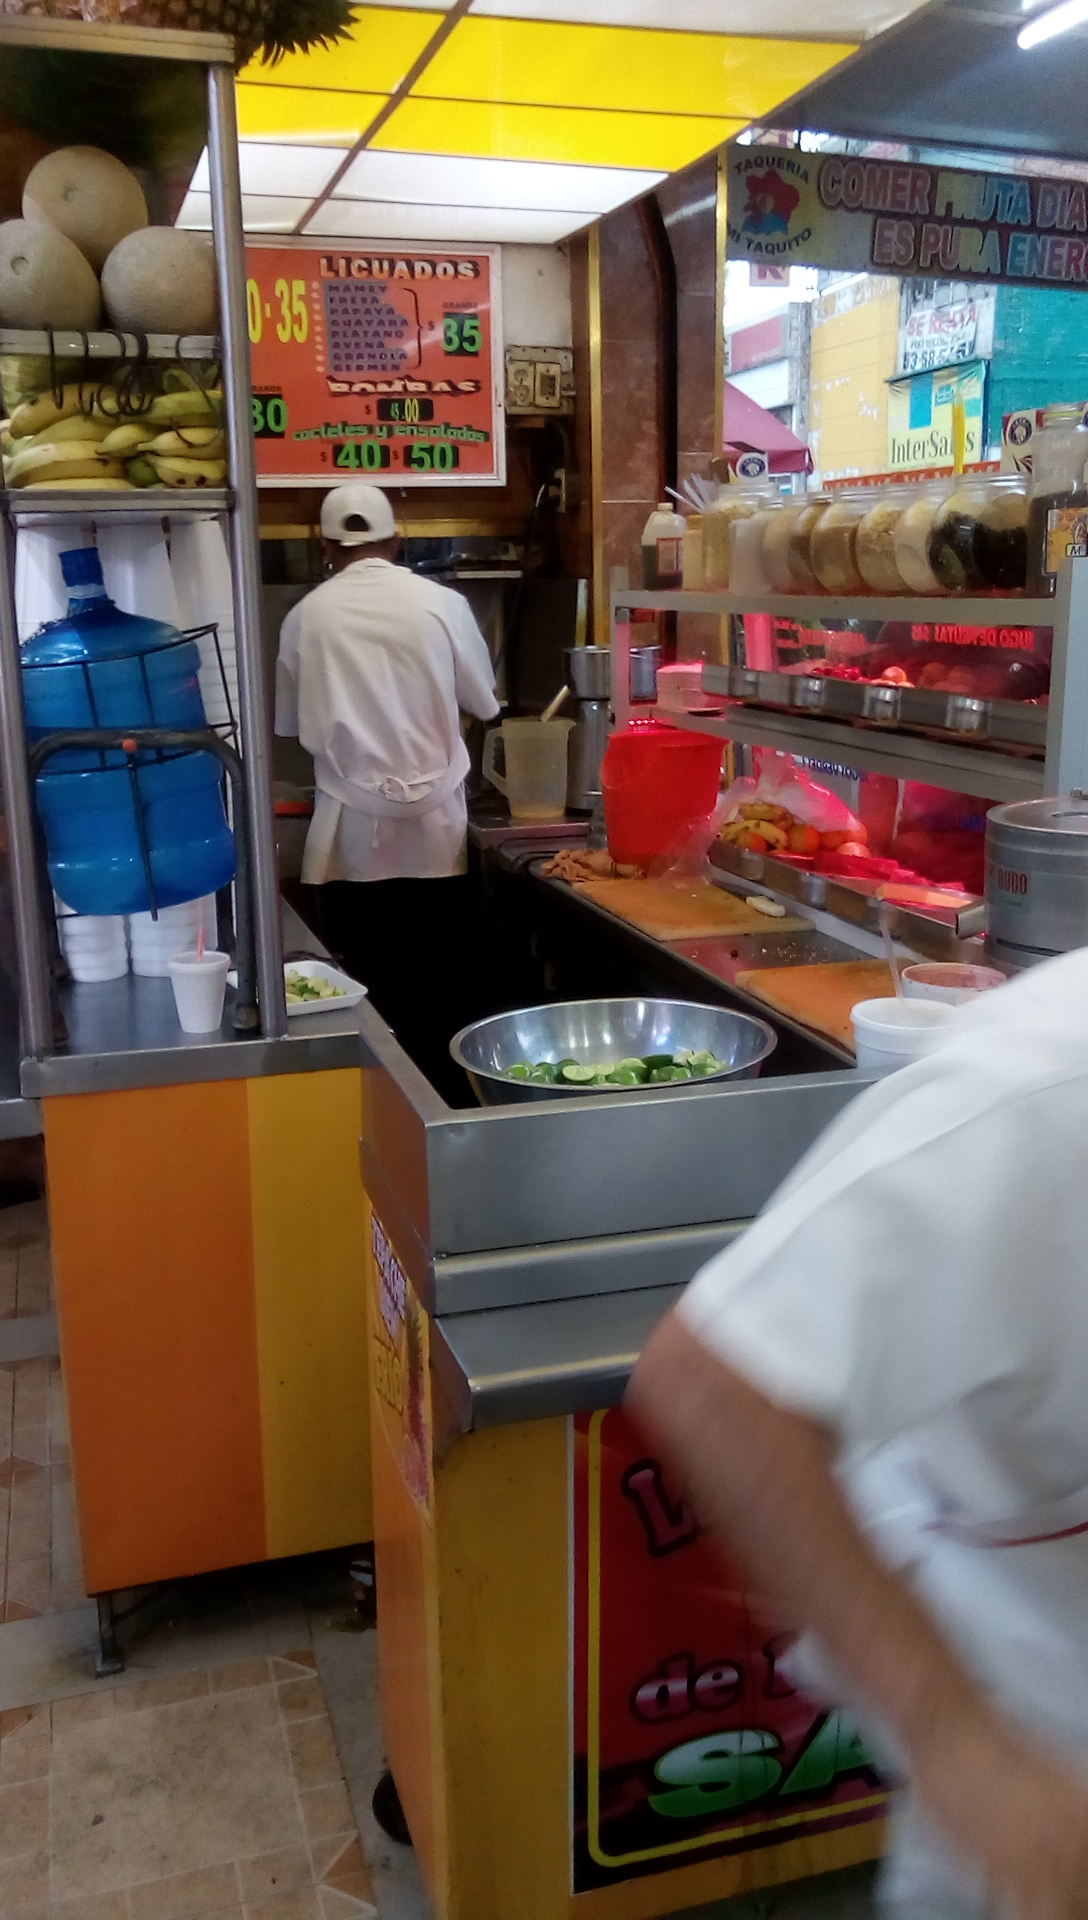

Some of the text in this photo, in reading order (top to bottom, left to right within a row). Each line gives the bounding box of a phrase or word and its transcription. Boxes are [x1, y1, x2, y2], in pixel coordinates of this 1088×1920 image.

[735, 156, 809, 184] TAQUERIA
[817, 157, 1088, 232] COMER FRUTA DIA
[745, 226, 812, 256] TAQUITO
[872, 217, 1088, 283] ES PURA ENER
[319, 255, 481, 282] LICUADOS
[330, 307, 395, 315] PAPAYA
[442, 318, 483, 353] 35
[326, 374, 482, 397] BOMBAS
[375, 424, 391, 439] y
[891, 430, 975, 464] InterSas
[336, 440, 382, 472] 40
[410, 441, 455, 473] 50
[630, 1652, 742, 1725] de
